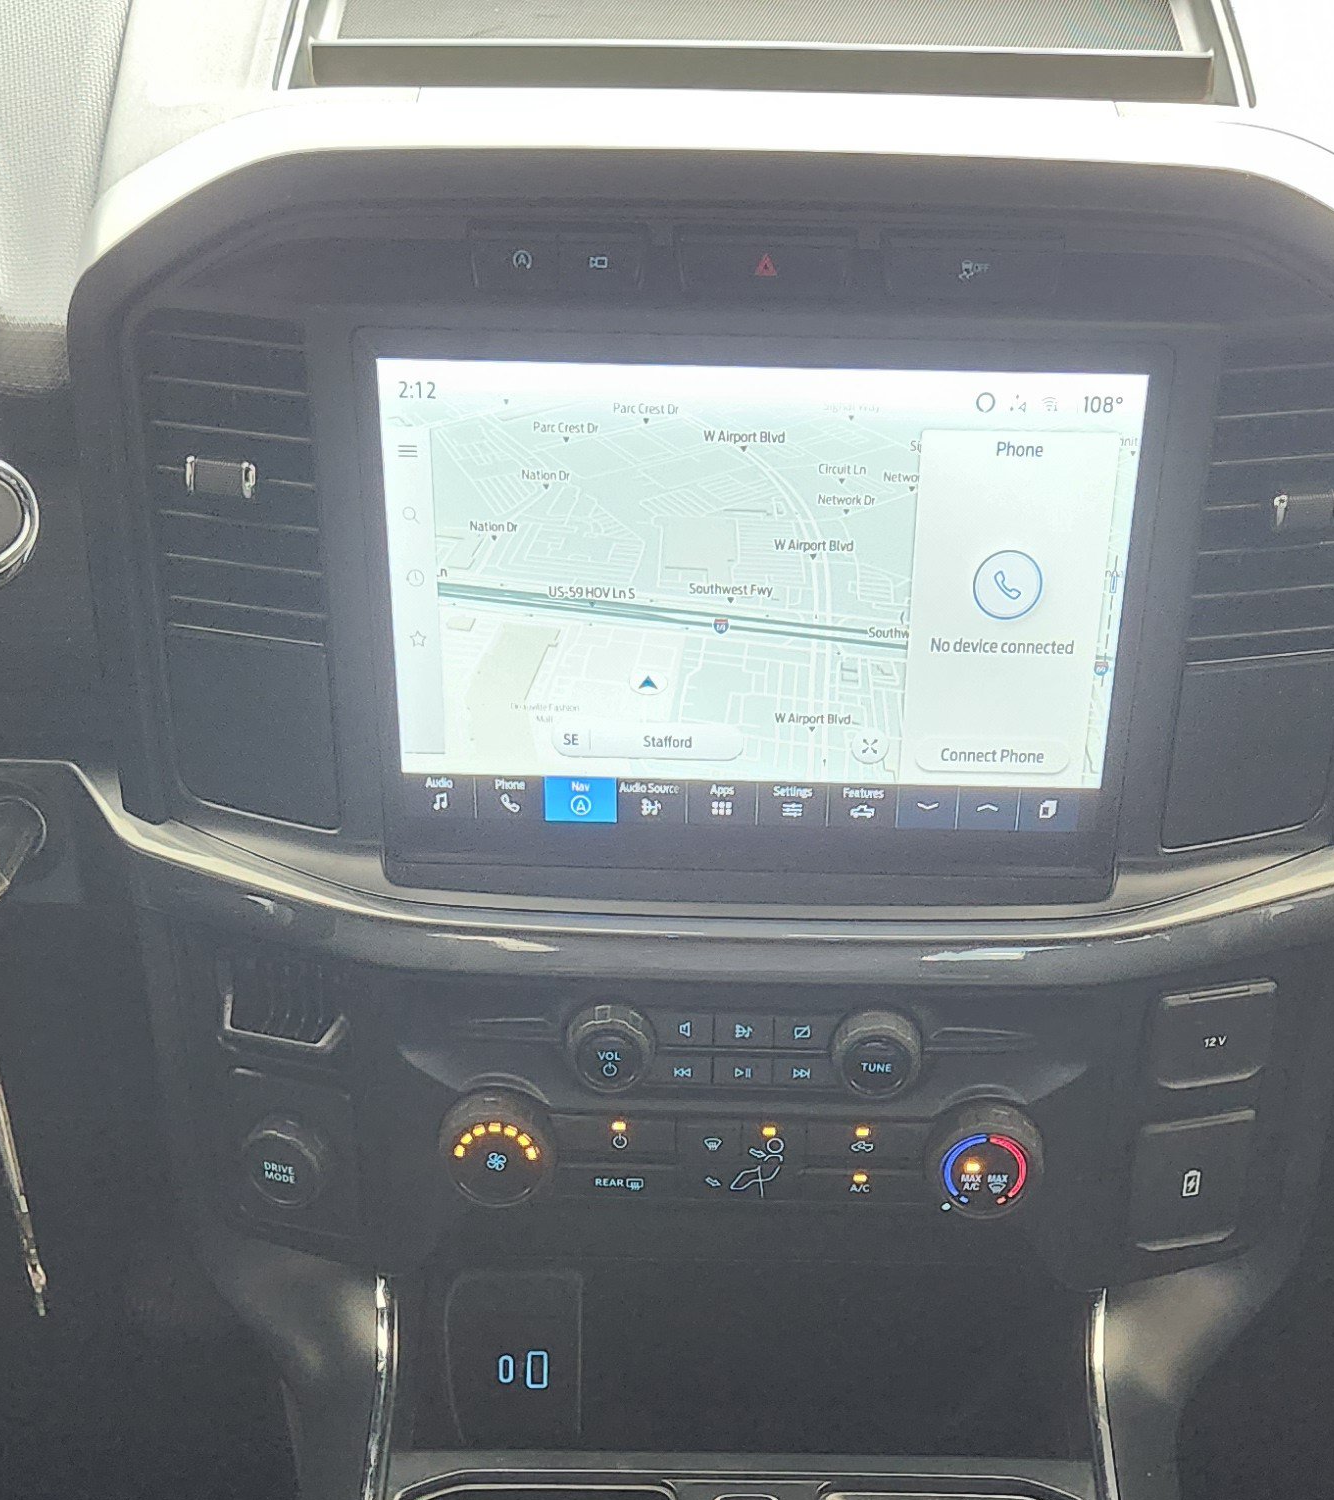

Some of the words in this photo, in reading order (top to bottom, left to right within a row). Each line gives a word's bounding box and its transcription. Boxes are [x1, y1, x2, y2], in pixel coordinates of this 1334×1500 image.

[398, 380, 437, 400] 2:12
[613, 402, 635, 414] Parc
[638, 403, 665, 415] Crest
[667, 403, 679, 415] Dr
[1083, 395, 1124, 414] 108°
[533, 421, 556, 434] Parc
[558, 422, 585, 434] Crest
[587, 422, 599, 434] Dr
[703, 430, 716, 443] W
[718, 430, 757, 445] Airport
[760, 431, 785, 444] Blvd
[996, 440, 1044, 458] Phone
[521, 469, 556, 481] Nation
[559, 470, 570, 482] Dr
[818, 463, 850, 475] Circuit
[853, 464, 867, 475] Ln
[817, 494, 861, 506] Network
[864, 495, 875, 506] Dr
[469, 520, 504, 532] Nation
[506, 521, 517, 532] Dr
[774, 538, 786, 551] W
[788, 539, 827, 553] Airport
[829, 539, 854, 551] Blvd
[548, 585, 583, 598] US-59
[585, 586, 610, 599] HOV
[612, 587, 626, 599] Ln
[628, 588, 636, 599] S
[688, 583, 748, 595] Southwest
[750, 584, 773, 597] Fwy
[930, 637, 950, 653] No
[953, 638, 998, 654] device
[1000, 639, 1075, 655] connected
[774, 712, 786, 724] W
[788, 713, 825, 726] Airport
[827, 714, 851, 725] Blvd
[563, 733, 579, 746] SE
[643, 735, 693, 749] Stafford
[940, 747, 997, 763] Connect
[999, 748, 1045, 764] Phone
[425, 776, 454, 789] Audio
[494, 779, 526, 792] Phone
[571, 780, 590, 792] Nav
[618, 782, 646, 794] Audio
[647, 783, 680, 795] Source
[709, 783, 735, 798] Apps
[772, 785, 813, 799] Settings
[842, 786, 885, 800] Features
[1203, 1036, 1217, 1048] 12
[1217, 1035, 1227, 1046] V
[597, 1051, 622, 1061] VOL
[860, 1062, 892, 1073] TUNE
[263, 1161, 295, 1176] DRIVE
[264, 1170, 296, 1184] MODE
[594, 1178, 624, 1187] REAR
[960, 1174, 982, 1183] MAX
[987, 1174, 1008, 1183] MAX
[849, 1184, 871, 1193] A/C
[962, 1182, 980, 1191] A/C
